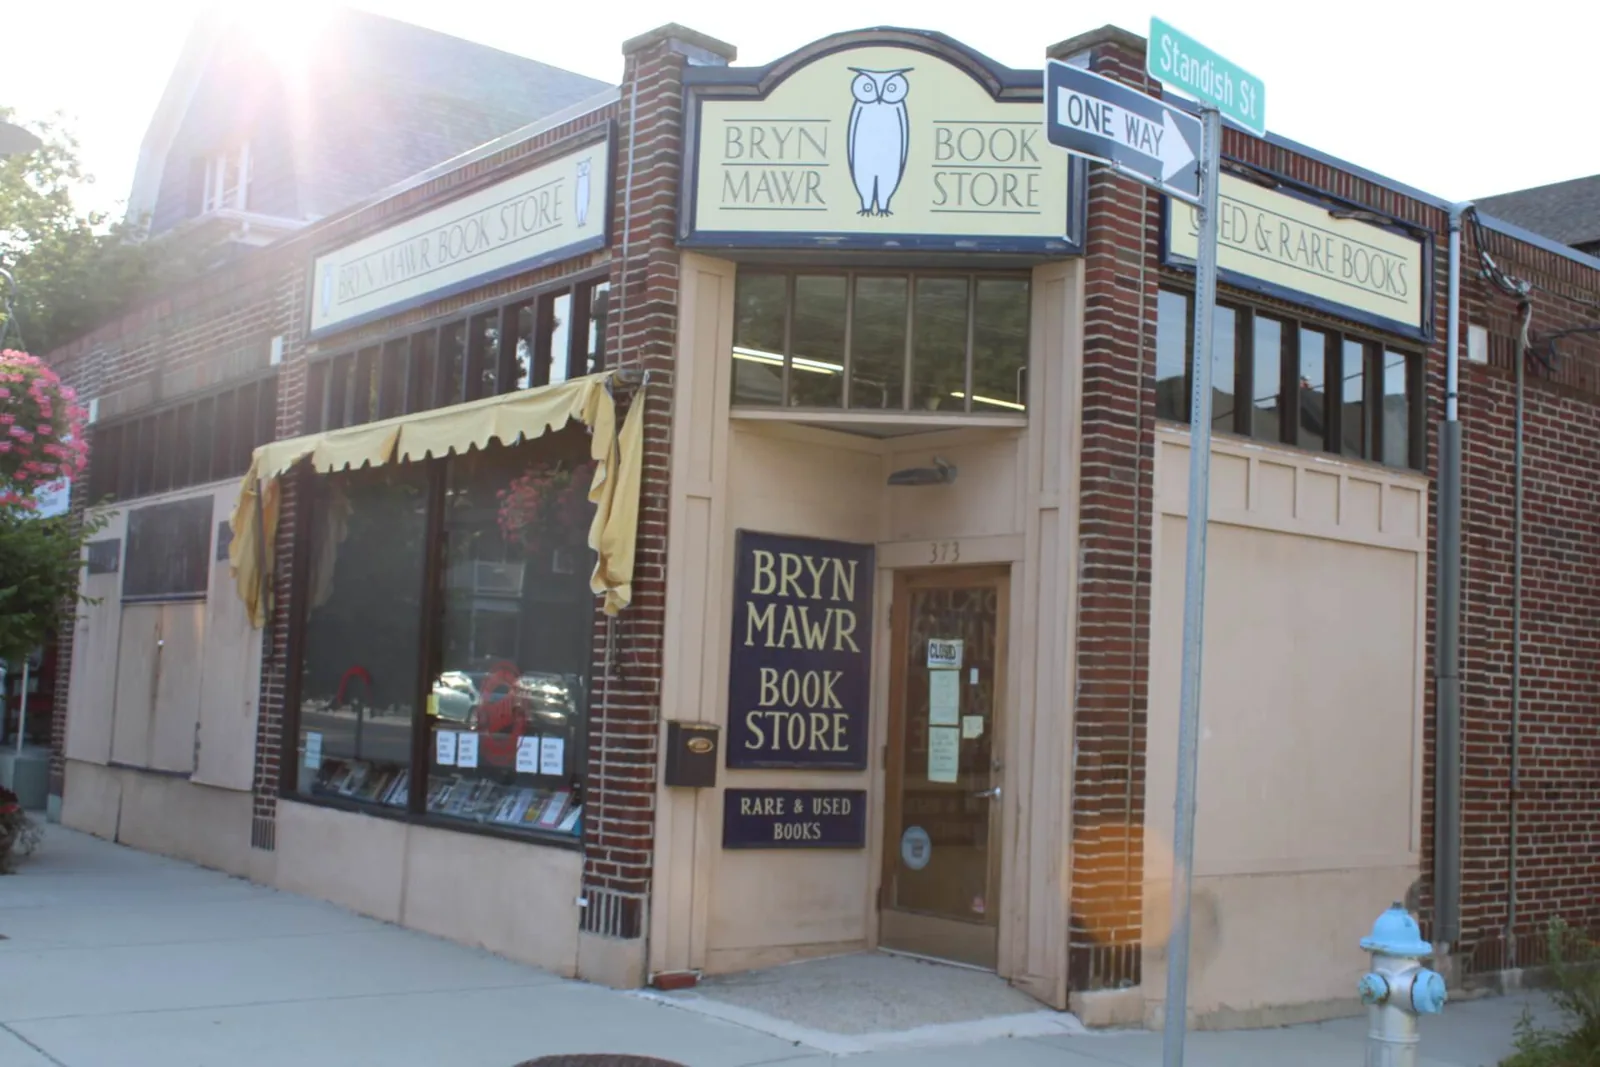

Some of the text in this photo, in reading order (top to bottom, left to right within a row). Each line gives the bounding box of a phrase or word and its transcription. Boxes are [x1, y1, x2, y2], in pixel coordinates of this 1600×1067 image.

[1160, 34, 1256, 120] Standish St
[724, 126, 828, 160] BRYN
[934, 127, 1039, 162] BOOK
[1067, 94, 1164, 157] ONE WAY
[721, 169, 826, 205] MAWR
[932, 171, 1039, 207] STORE
[379, 237, 432, 285] MAWR
[438, 213, 491, 264] BOOK
[498, 184, 563, 242] STORE
[1255, 212, 1272, 253] &
[1279, 221, 1334, 274] RARE
[1342, 242, 1408, 297] BOOKS
[929, 541, 961, 565] 373
[751, 549, 858, 602] BRYN
[744, 601, 860, 653] MAWR
[758, 667, 843, 709] BOOK
[744, 710, 850, 752] STORE
[740, 797, 851, 815] RARE & USED
[773, 822, 822, 840] BOOKS
